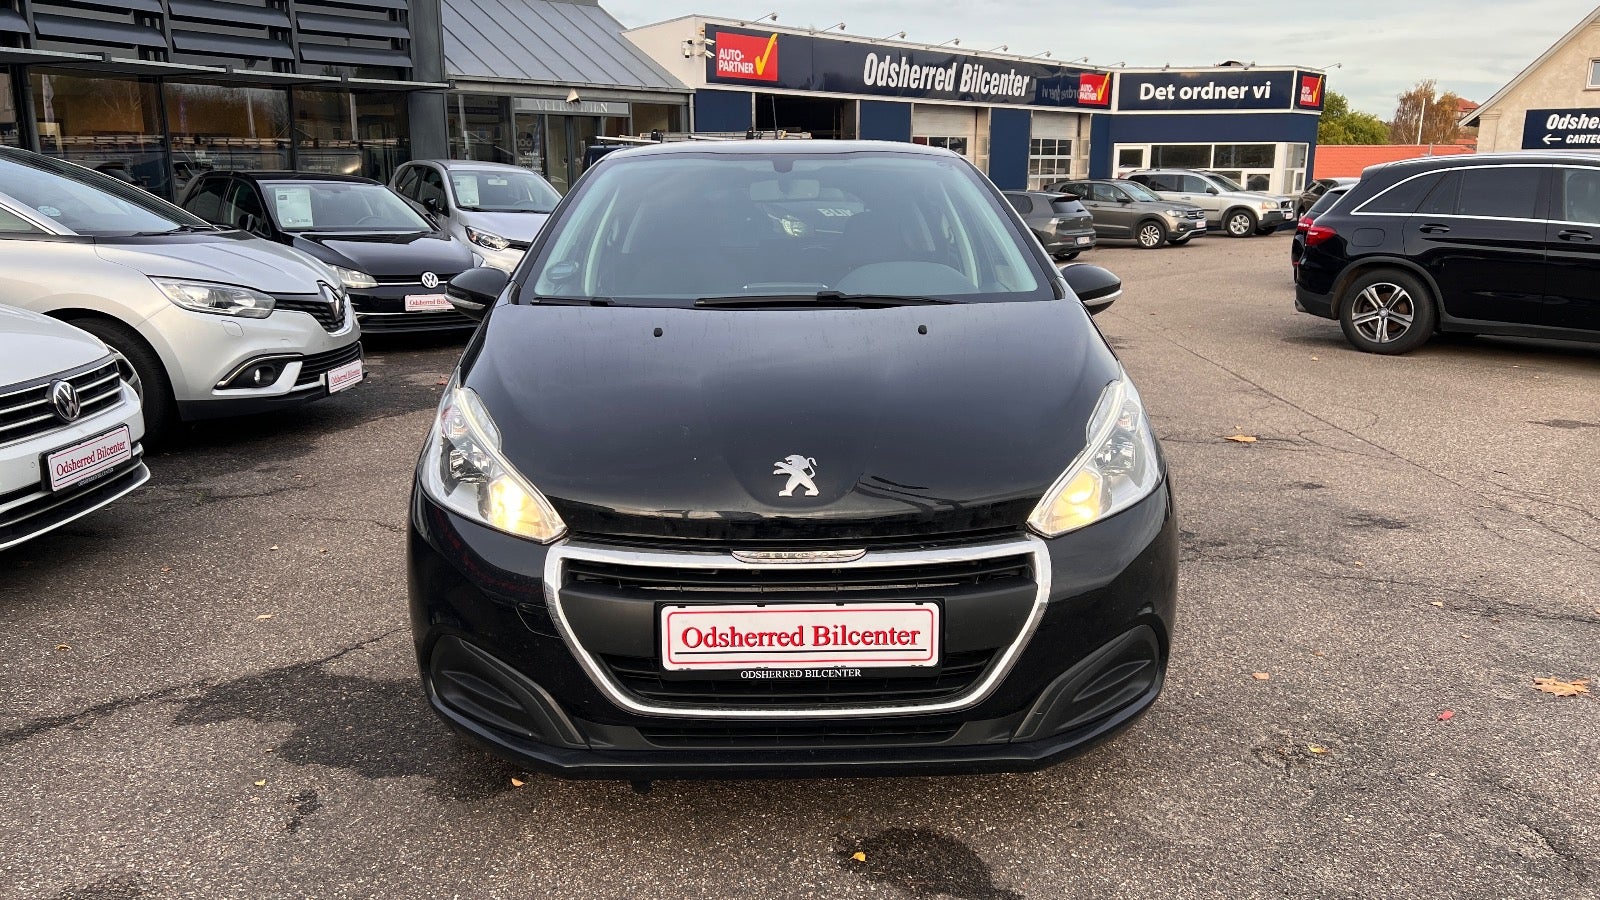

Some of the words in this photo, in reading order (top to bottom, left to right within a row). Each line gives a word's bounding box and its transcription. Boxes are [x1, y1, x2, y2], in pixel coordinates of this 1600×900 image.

[718, 47, 745, 62] AUTO-
[718, 58, 755, 75] PARTNER
[863, 52, 958, 91] Odsherred
[959, 63, 1030, 98] Bilcenter
[1139, 82, 1175, 101] Det
[1183, 82, 1249, 100] ordner
[1252, 81, 1271, 99] vi
[56, 450, 96, 477] Odsherred
[96, 440, 126, 461] Bilcenter
[681, 625, 804, 648] Odsherred
[812, 624, 920, 647] Bilcenter
[740, 669, 803, 679] ODSHERRED
[804, 668, 862, 679] BILCENTER
